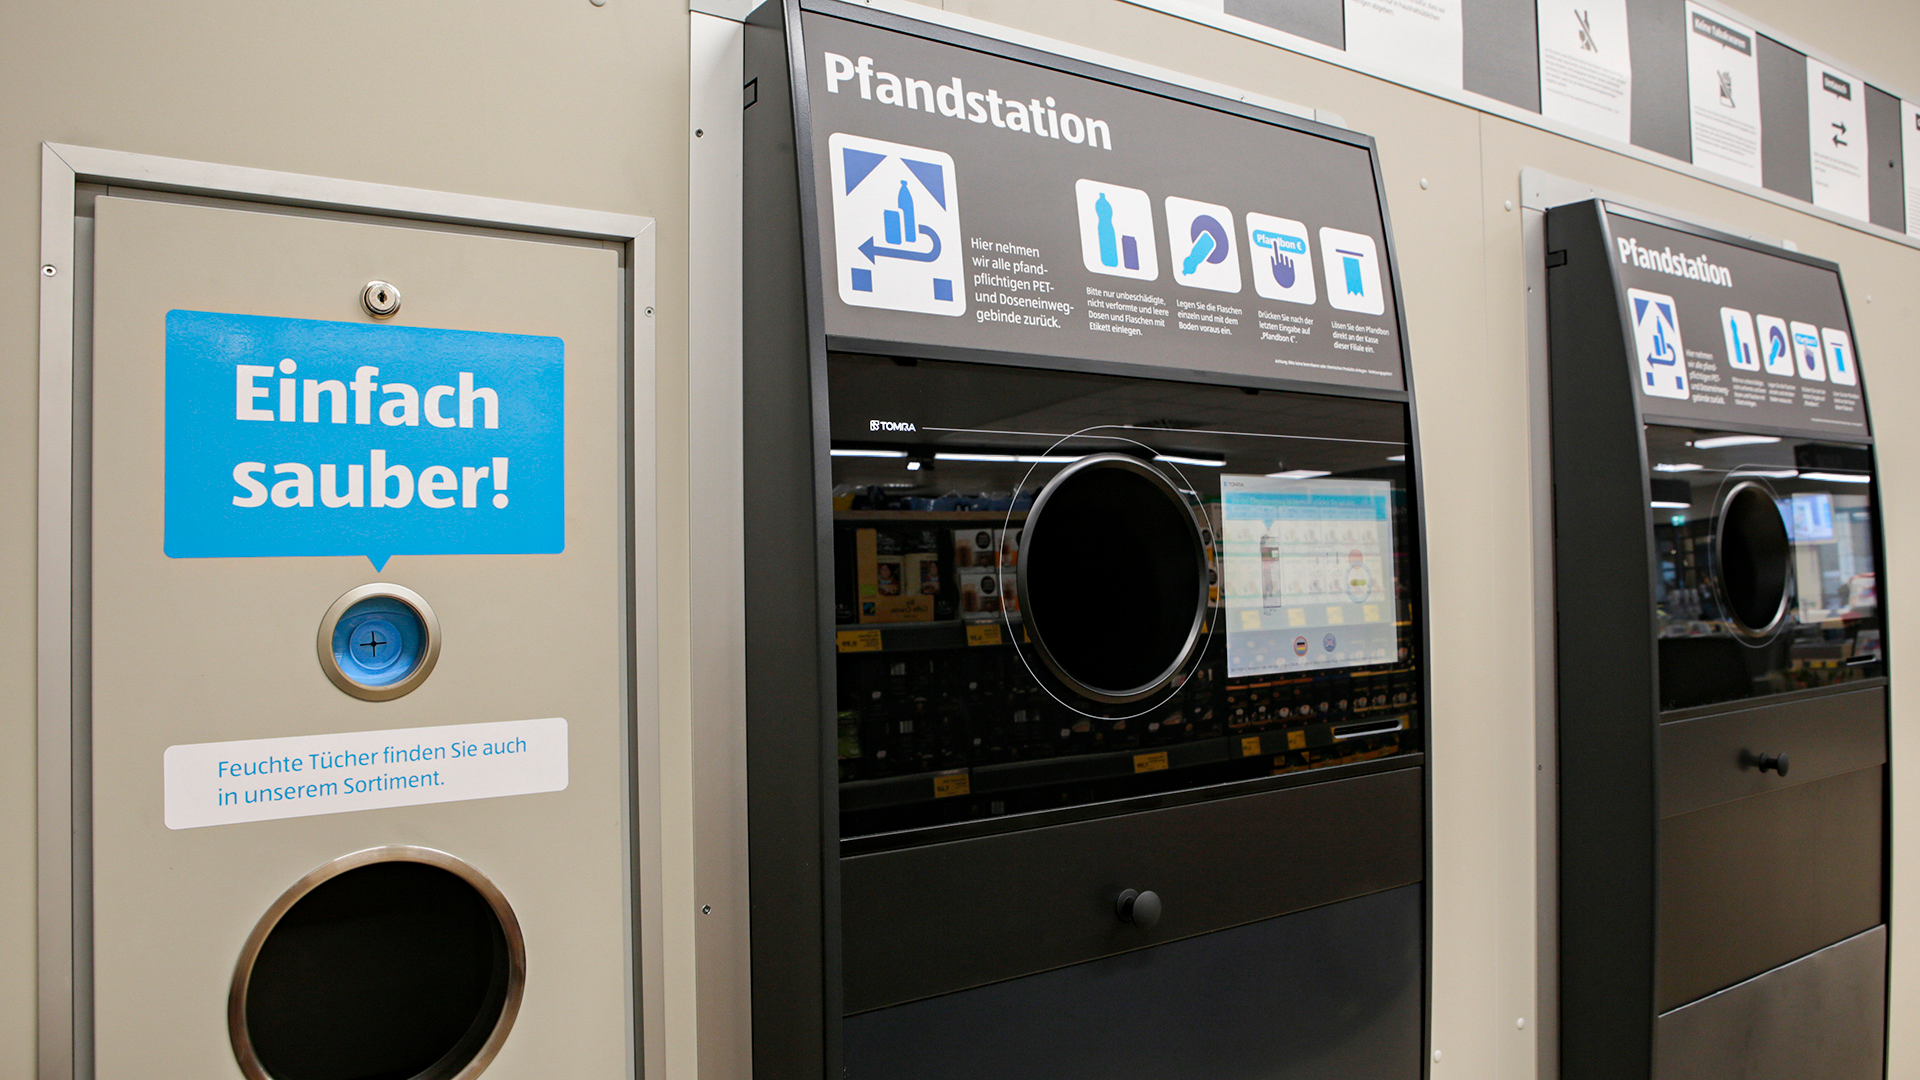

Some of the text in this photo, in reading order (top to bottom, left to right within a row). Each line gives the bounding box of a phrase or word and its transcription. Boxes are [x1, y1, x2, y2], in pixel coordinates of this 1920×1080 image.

[824, 52, 1112, 150] Pfandstation
[970, 238, 1040, 258] Hier nehmen
[972, 255, 1048, 275] wir alle pfand-
[1616, 236, 1733, 288] Pfandstation
[974, 272, 1054, 292] pflichtigen PET-
[975, 292, 1074, 316] und Doseneinweg-
[1086, 286, 1166, 306] Bitte nur unbeschädigte,
[1088, 298, 1170, 316] nicht verformte und leere
[1176, 299, 1242, 316] Legen Sie die Flaschen
[976, 308, 1061, 328] gebinde zurück.
[1088, 310, 1166, 328] Dosen und Flaschen mit
[1178, 310, 1238, 326] einzeln und mit dem
[1258, 310, 1314, 326] Drücken Sie nach der
[1346, 323, 1354, 331] Sie
[1354, 324, 1365, 332] den
[1089, 322, 1143, 336] Etikett einlegen.
[1178, 322, 1232, 336] Boden voraus ein.
[1278, 324, 1301, 334] Eingabe
[1302, 327, 1310, 335] auf
[1356, 334, 1364, 342] der
[235, 358, 500, 430] Einfach
[880, 420, 916, 432] TOMRA
[232, 449, 510, 510] sauber!
[218, 736, 528, 778] Feuchte Tücher finden Sie auch
[218, 770, 445, 806] in unserem Sortiment.
